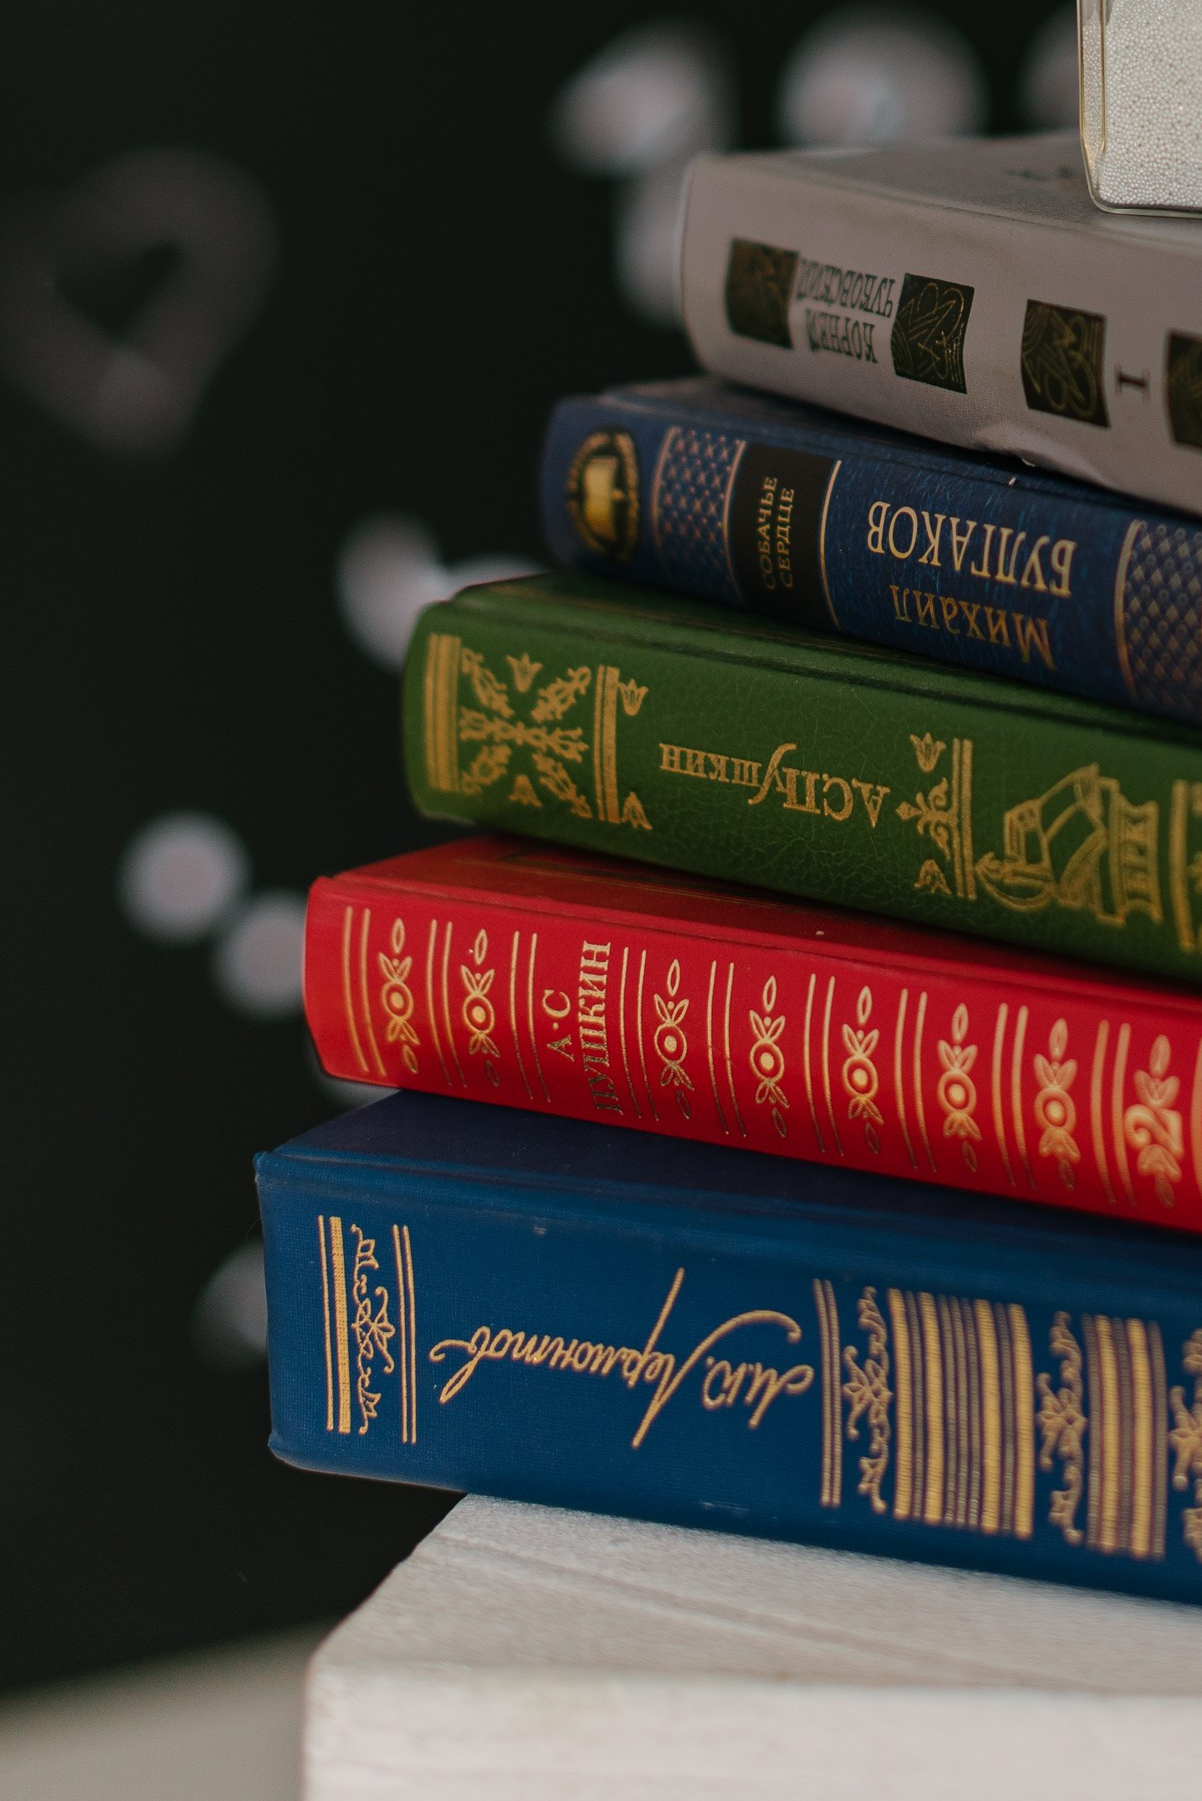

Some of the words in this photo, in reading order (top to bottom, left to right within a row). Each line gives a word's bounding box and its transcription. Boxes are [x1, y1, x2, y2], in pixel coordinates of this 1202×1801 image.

[757, 475, 780, 591] СОБАЧЬЕ
[774, 486, 797, 589] СЕРДЦЕ
[864, 499, 1080, 599] БУЛГАКОВ
[887, 582, 1058, 672] Михаил
[577, 939, 625, 1116] ПУШКИН
[428, 1265, 804, 1451] Лермонтов
